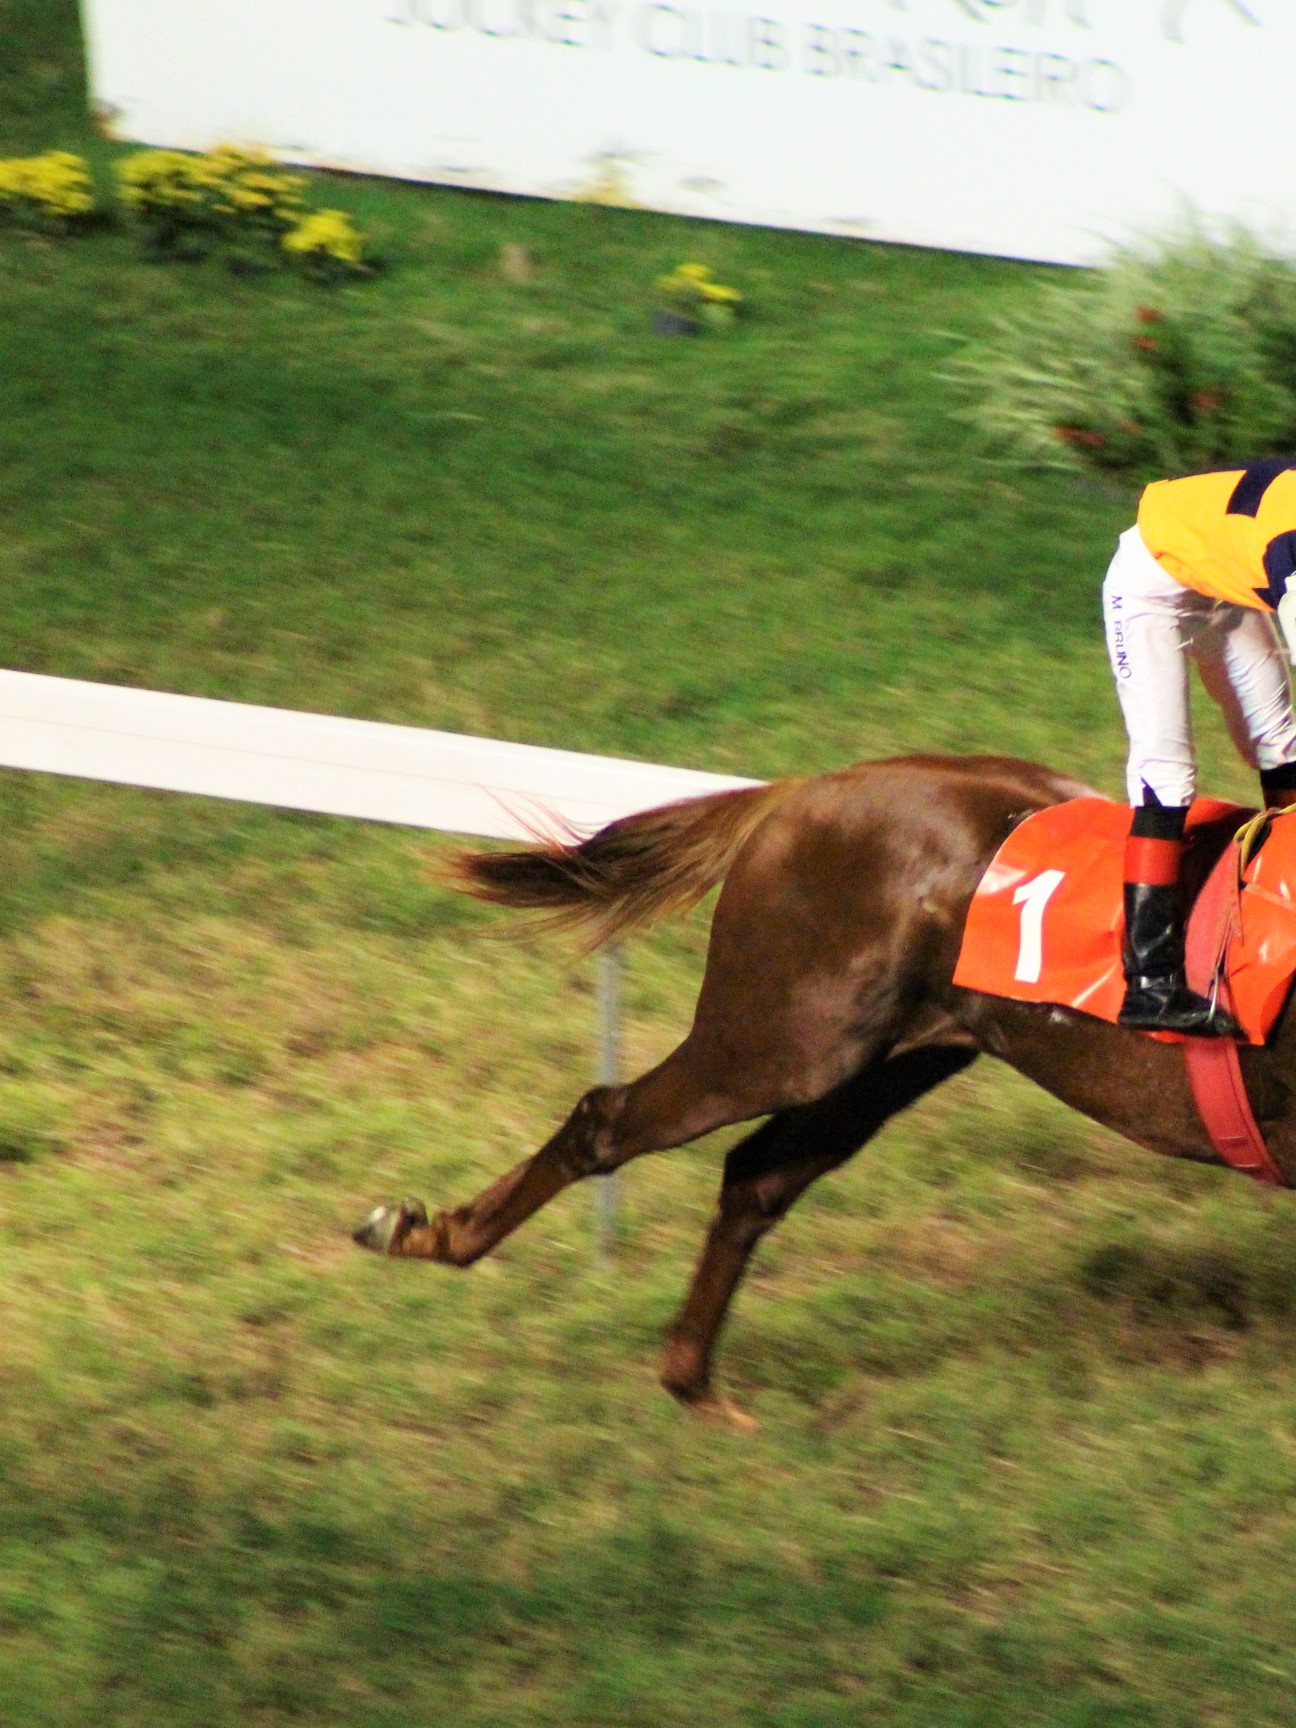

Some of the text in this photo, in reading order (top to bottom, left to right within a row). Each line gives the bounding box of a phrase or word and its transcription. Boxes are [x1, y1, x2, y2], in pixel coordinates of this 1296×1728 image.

[634, 1, 791, 71] CLUB
[803, 22, 1131, 113] BRASILEIRO
[1012, 869, 1066, 983] 1
